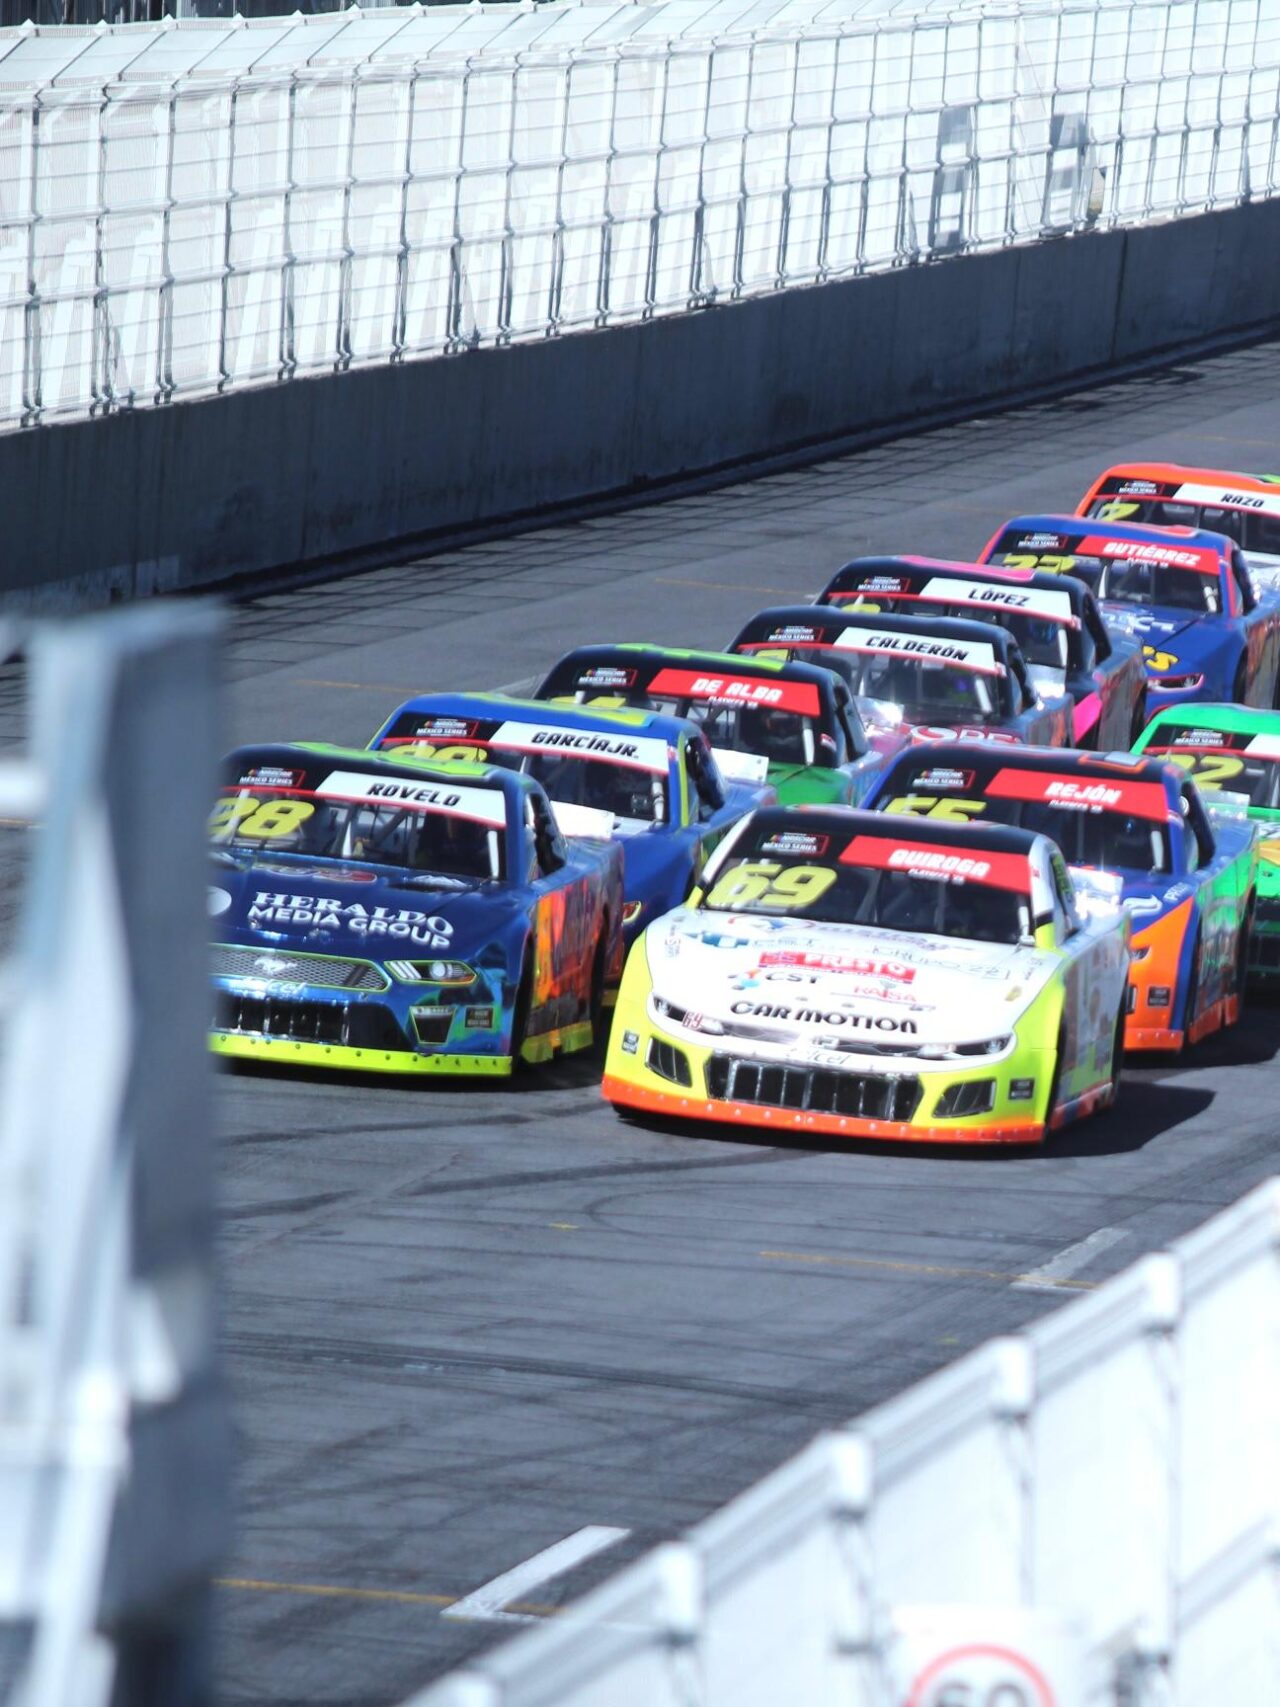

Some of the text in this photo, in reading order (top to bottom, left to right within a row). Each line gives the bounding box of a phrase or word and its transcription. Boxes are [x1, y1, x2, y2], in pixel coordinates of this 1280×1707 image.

[1220, 493, 1266, 508] RAZO
[968, 588, 1031, 607] LÓPEZ
[865, 635, 969, 661] CALDERÓN
[691, 677, 784, 703] DE ALBA
[366, 783, 462, 807] ROVELO
[1044, 780, 1123, 805] REJÓN
[887, 848, 992, 881] QUIROGA
[705, 863, 838, 908] 69
[247, 905, 451, 949] MEDIA GROUP
[252, 891, 455, 937] HERALDO
[765, 971, 822, 984] CST
[729, 1000, 919, 1034] CAR MOTION
